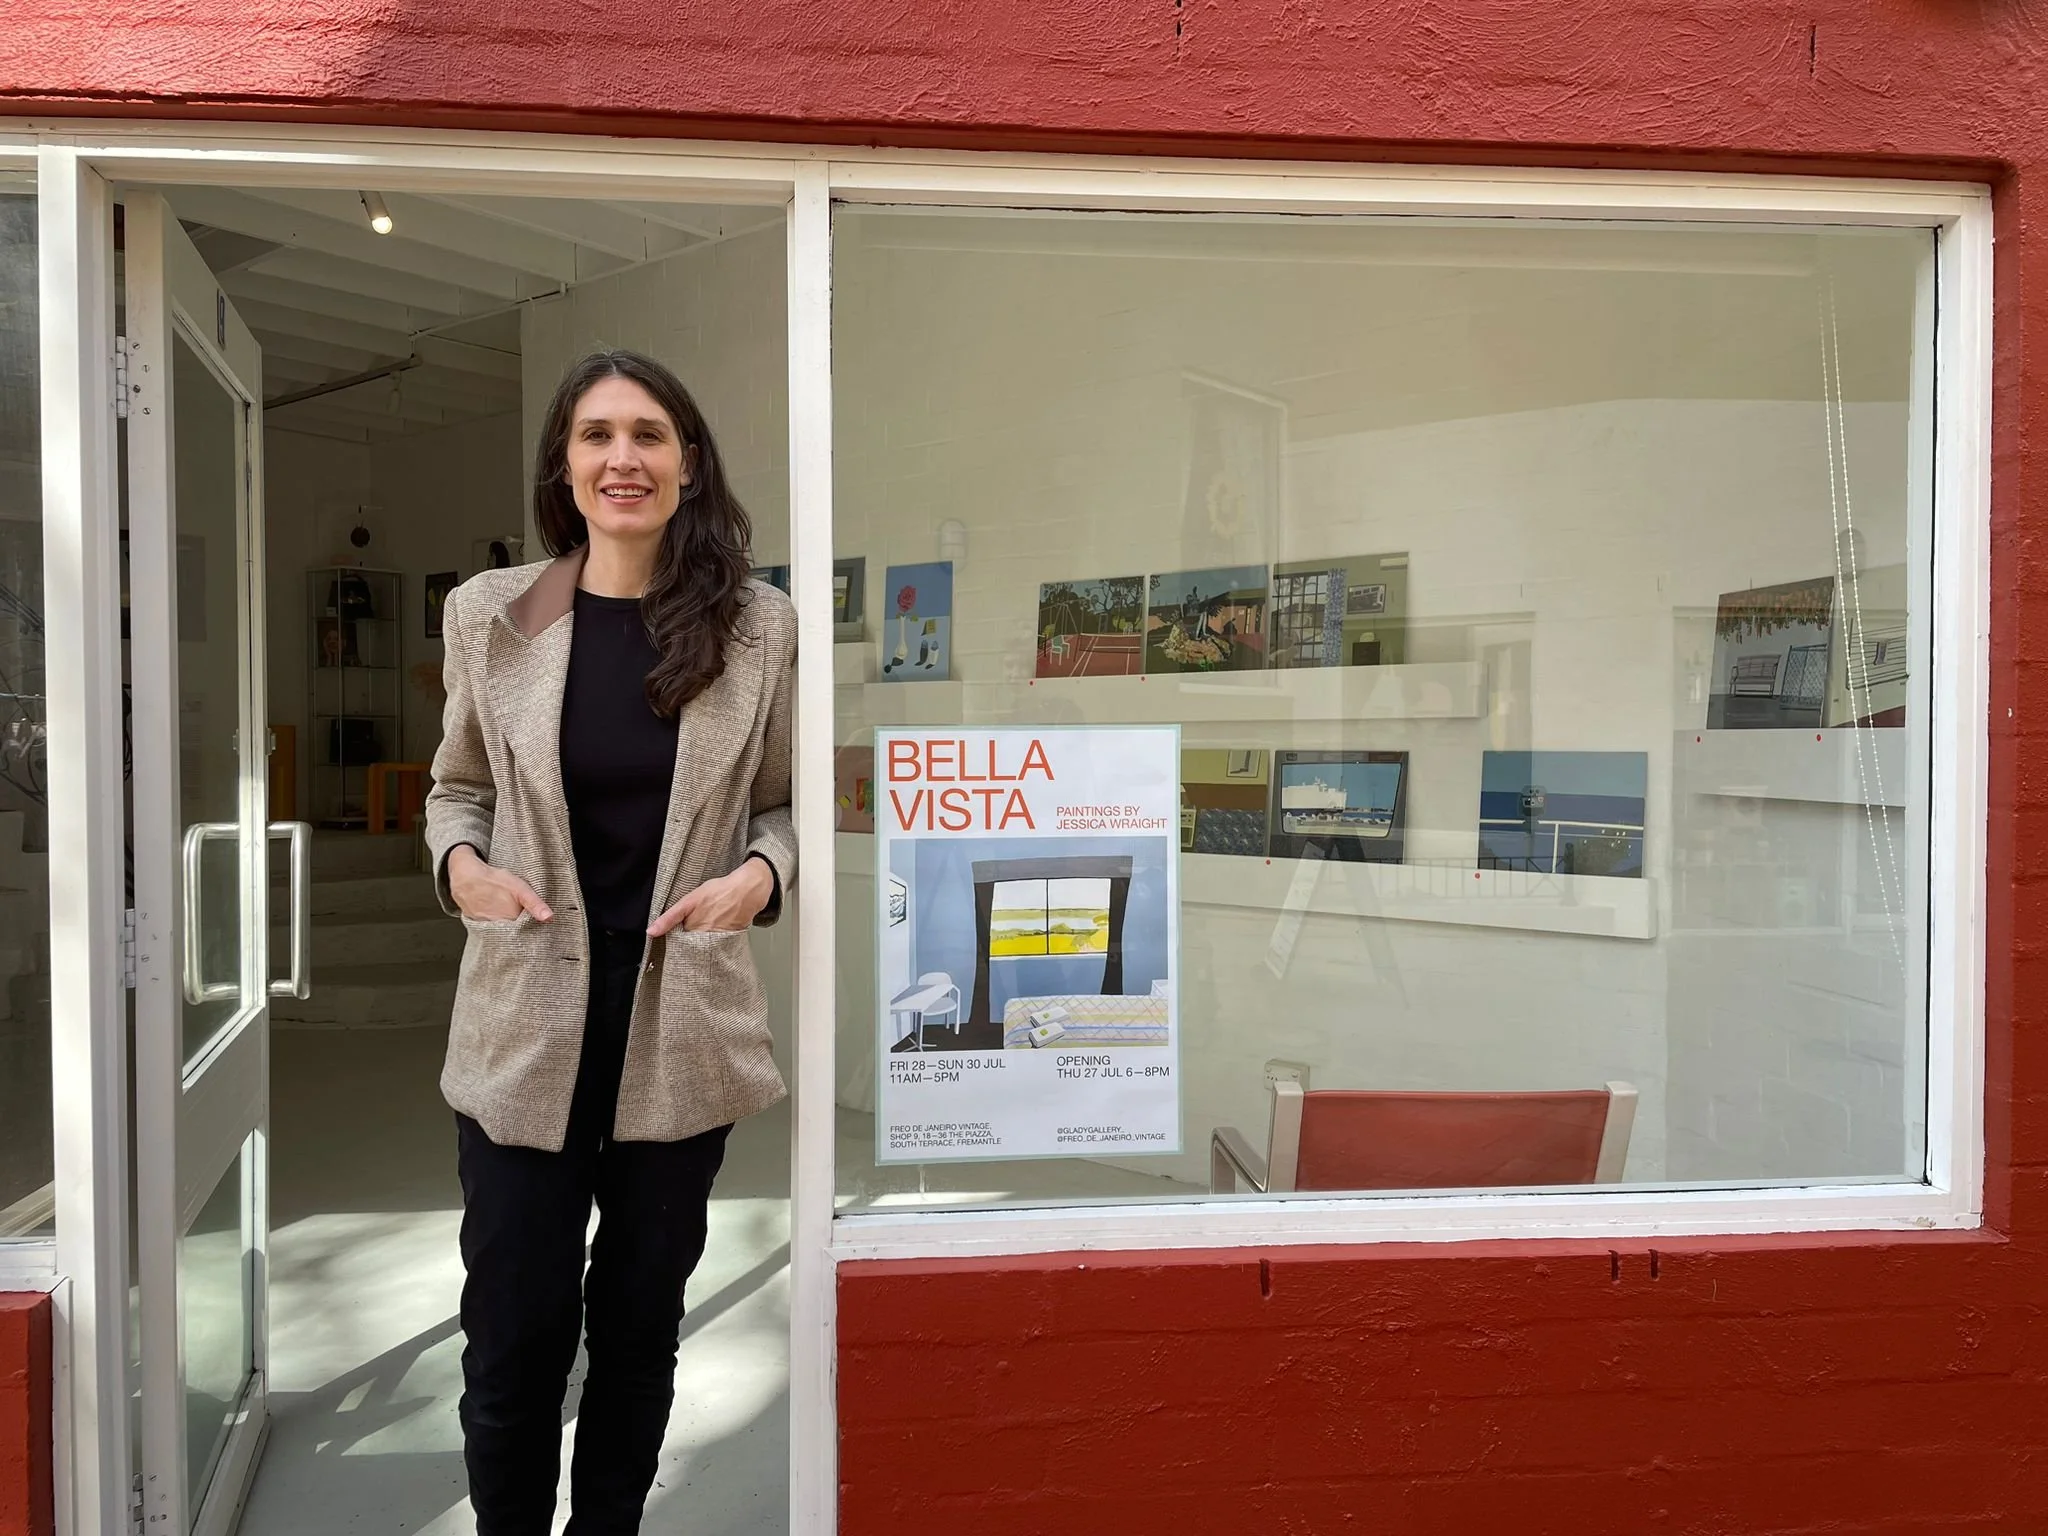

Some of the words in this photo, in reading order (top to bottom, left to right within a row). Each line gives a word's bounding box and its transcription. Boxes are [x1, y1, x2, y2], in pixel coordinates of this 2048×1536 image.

[888, 739, 1055, 782] BELLA
[889, 788, 1036, 831] VISTA
[1056, 806, 1121, 817] PAINTINGS
[1124, 806, 1140, 817] BY
[1056, 818, 1106, 830] JESSICA
[1107, 818, 1167, 830] WRAIGHT
[890, 1061, 908, 1072] FRI
[966, 1059, 981, 1070] 30
[983, 1058, 1006, 1069] JUL
[1056, 1055, 1111, 1066] OPENING
[1057, 1068, 1081, 1079] THU
[1084, 1068, 1098, 1078] 27
[1101, 1067, 1123, 1078] JUL
[890, 1125, 911, 1133] FREO
[924, 1124, 957, 1132] JANEIRO
[890, 1133, 912, 1141] SHOP
[949, 1131, 963, 1139] THE
[890, 1140, 917, 1149] SOUTH
[956, 1138, 1001, 1146] FREMANTLE
